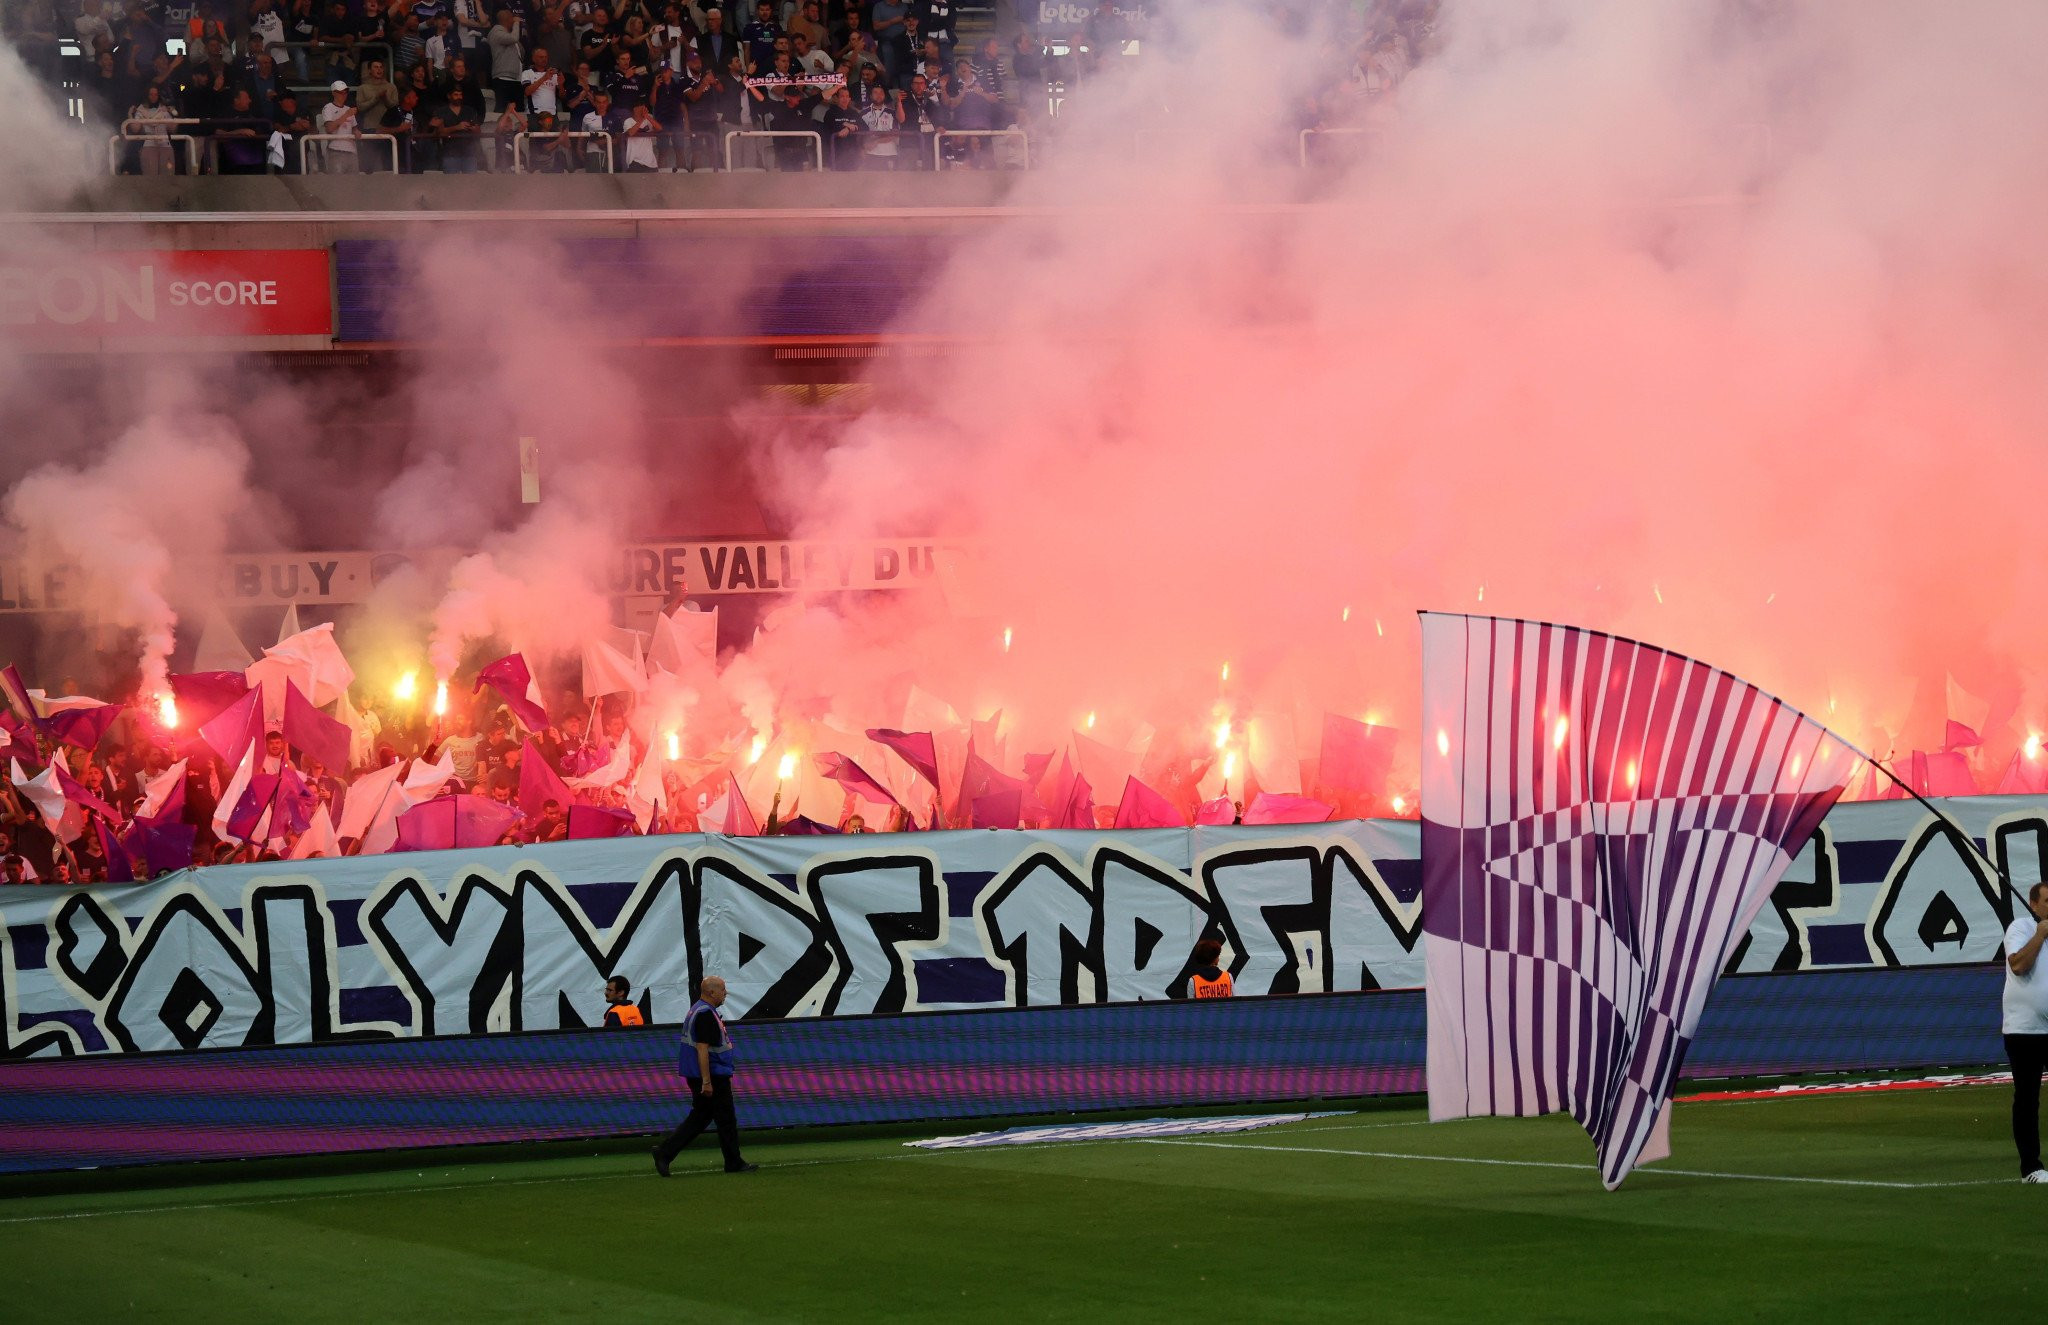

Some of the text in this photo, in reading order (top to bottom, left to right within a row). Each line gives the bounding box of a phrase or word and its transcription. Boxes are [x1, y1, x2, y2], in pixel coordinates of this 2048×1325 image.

[169, 280, 278, 306] SCORE
[700, 546, 855, 590] VALLEY
[1200, 983, 1229, 998] STEWARD
